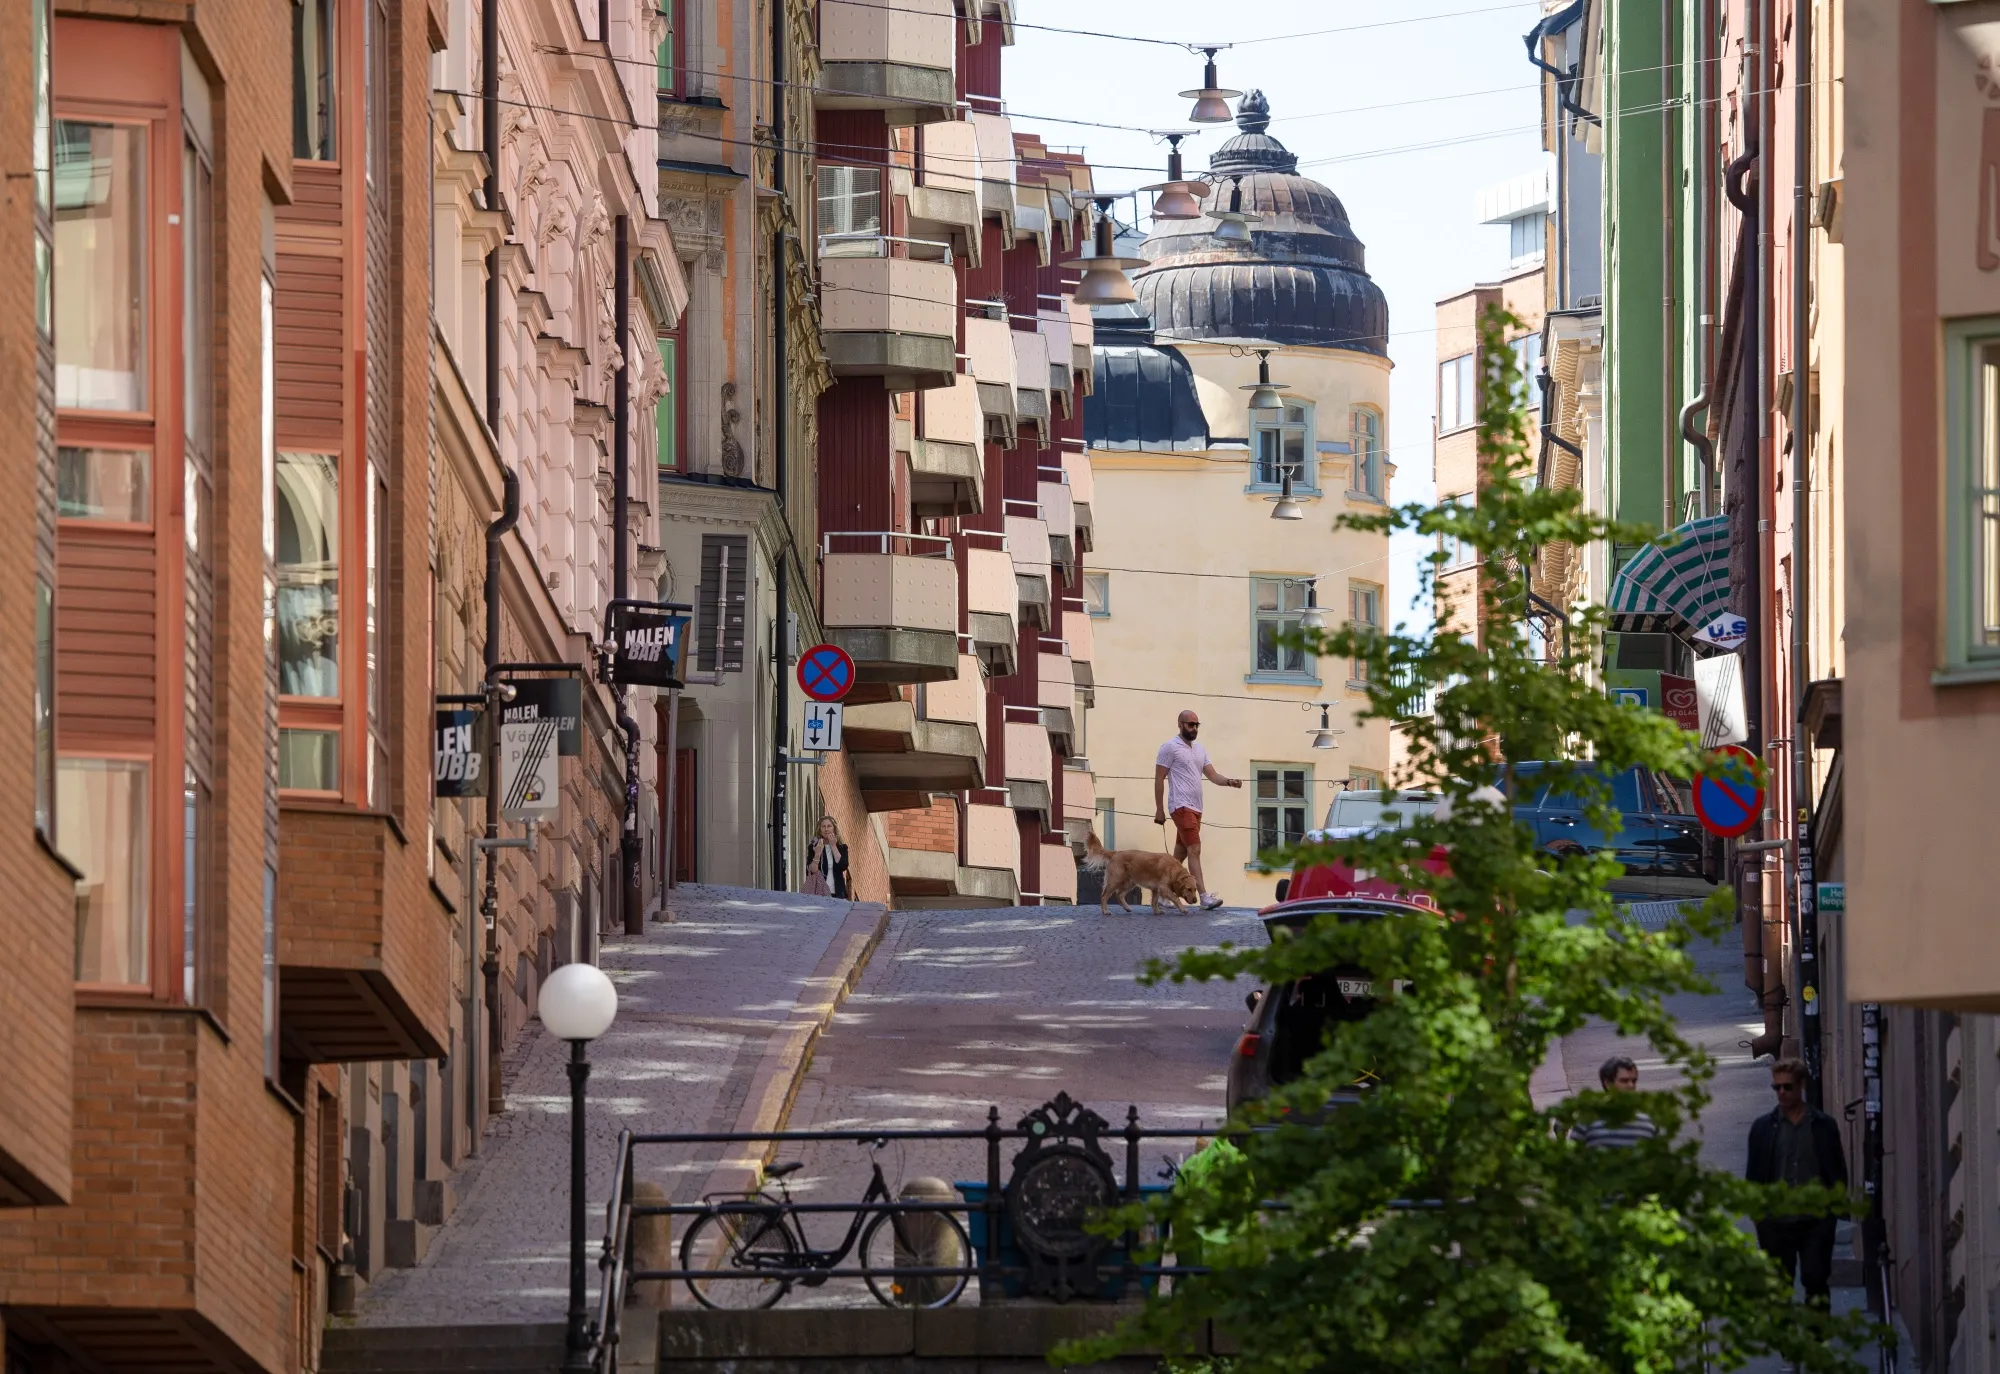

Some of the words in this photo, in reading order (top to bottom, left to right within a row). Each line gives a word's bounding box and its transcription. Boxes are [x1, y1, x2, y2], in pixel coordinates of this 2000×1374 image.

[625, 626, 675, 649] NALEN
[627, 642, 661, 662] BAR
[503, 704, 539, 724] NALEN
